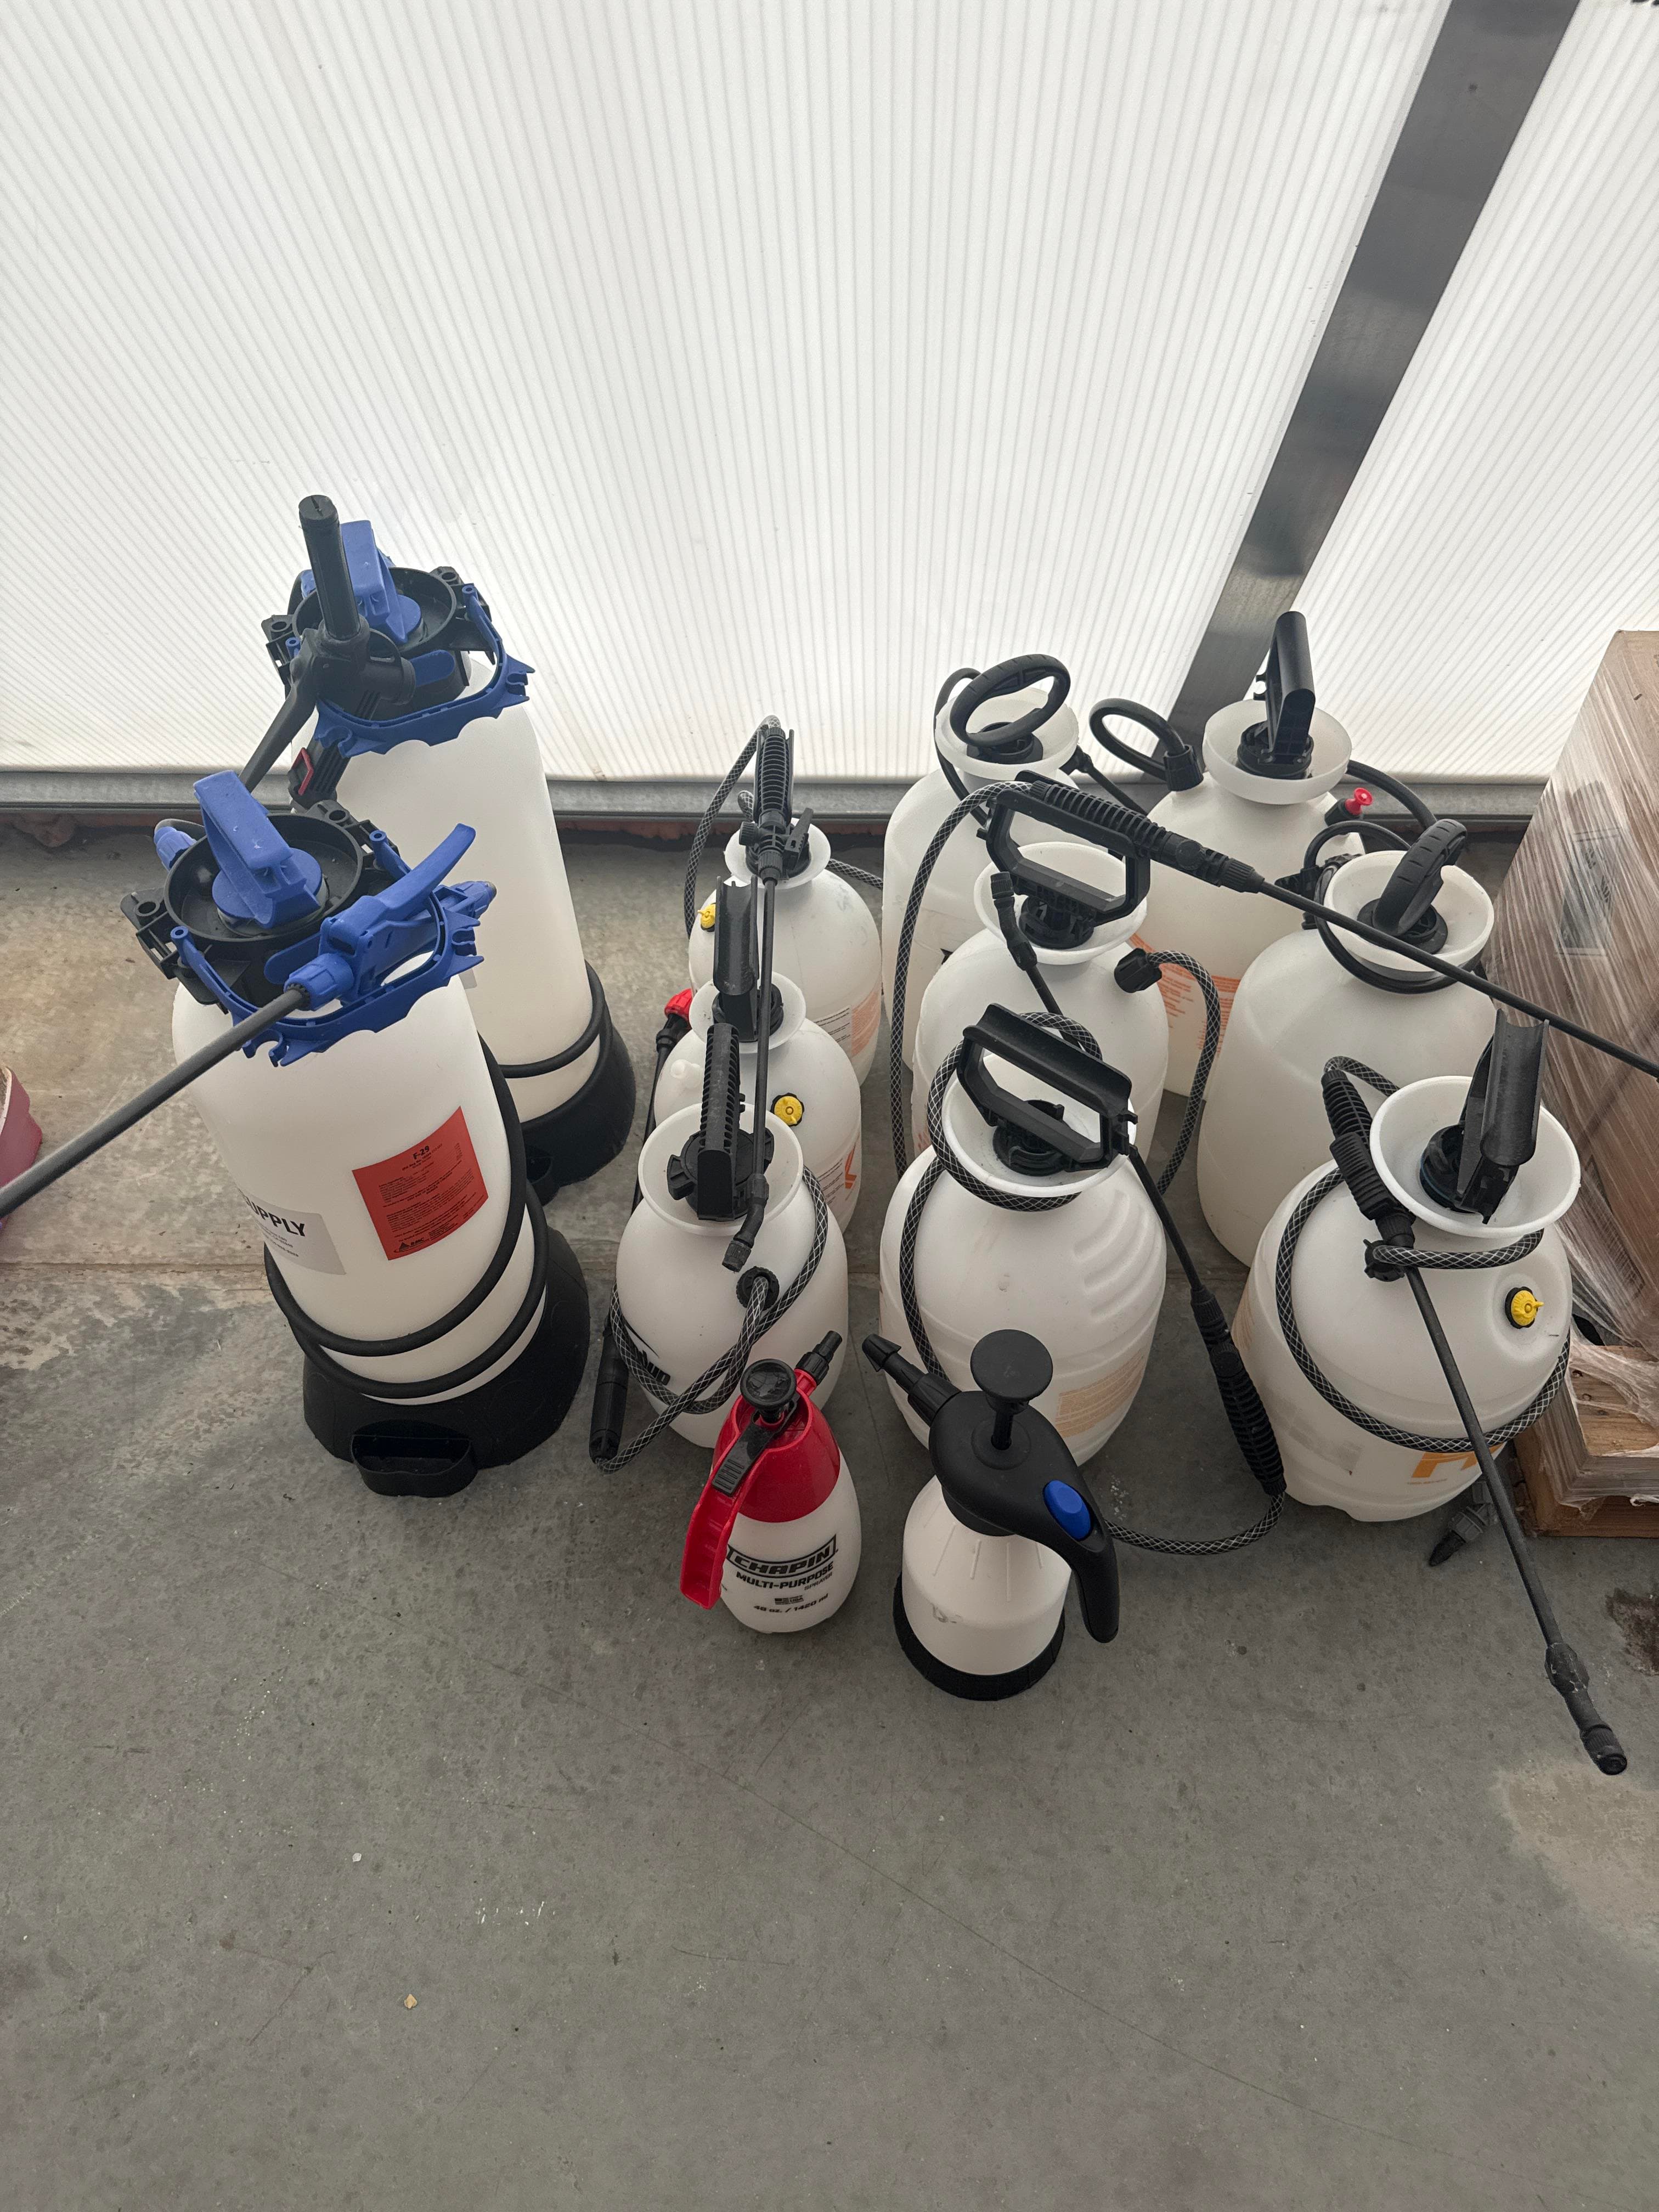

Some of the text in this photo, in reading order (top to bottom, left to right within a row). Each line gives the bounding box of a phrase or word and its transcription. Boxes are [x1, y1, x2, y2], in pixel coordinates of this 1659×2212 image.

[413, 1146, 430, 1160] F-29
[734, 1545, 831, 1575] CHAPIN
[736, 1561, 834, 1589] MULTI-PURPOSE
[804, 1572, 833, 1591] SPRAYER
[794, 1601, 817, 1611] 1420
[819, 1593, 828, 1603] ml
